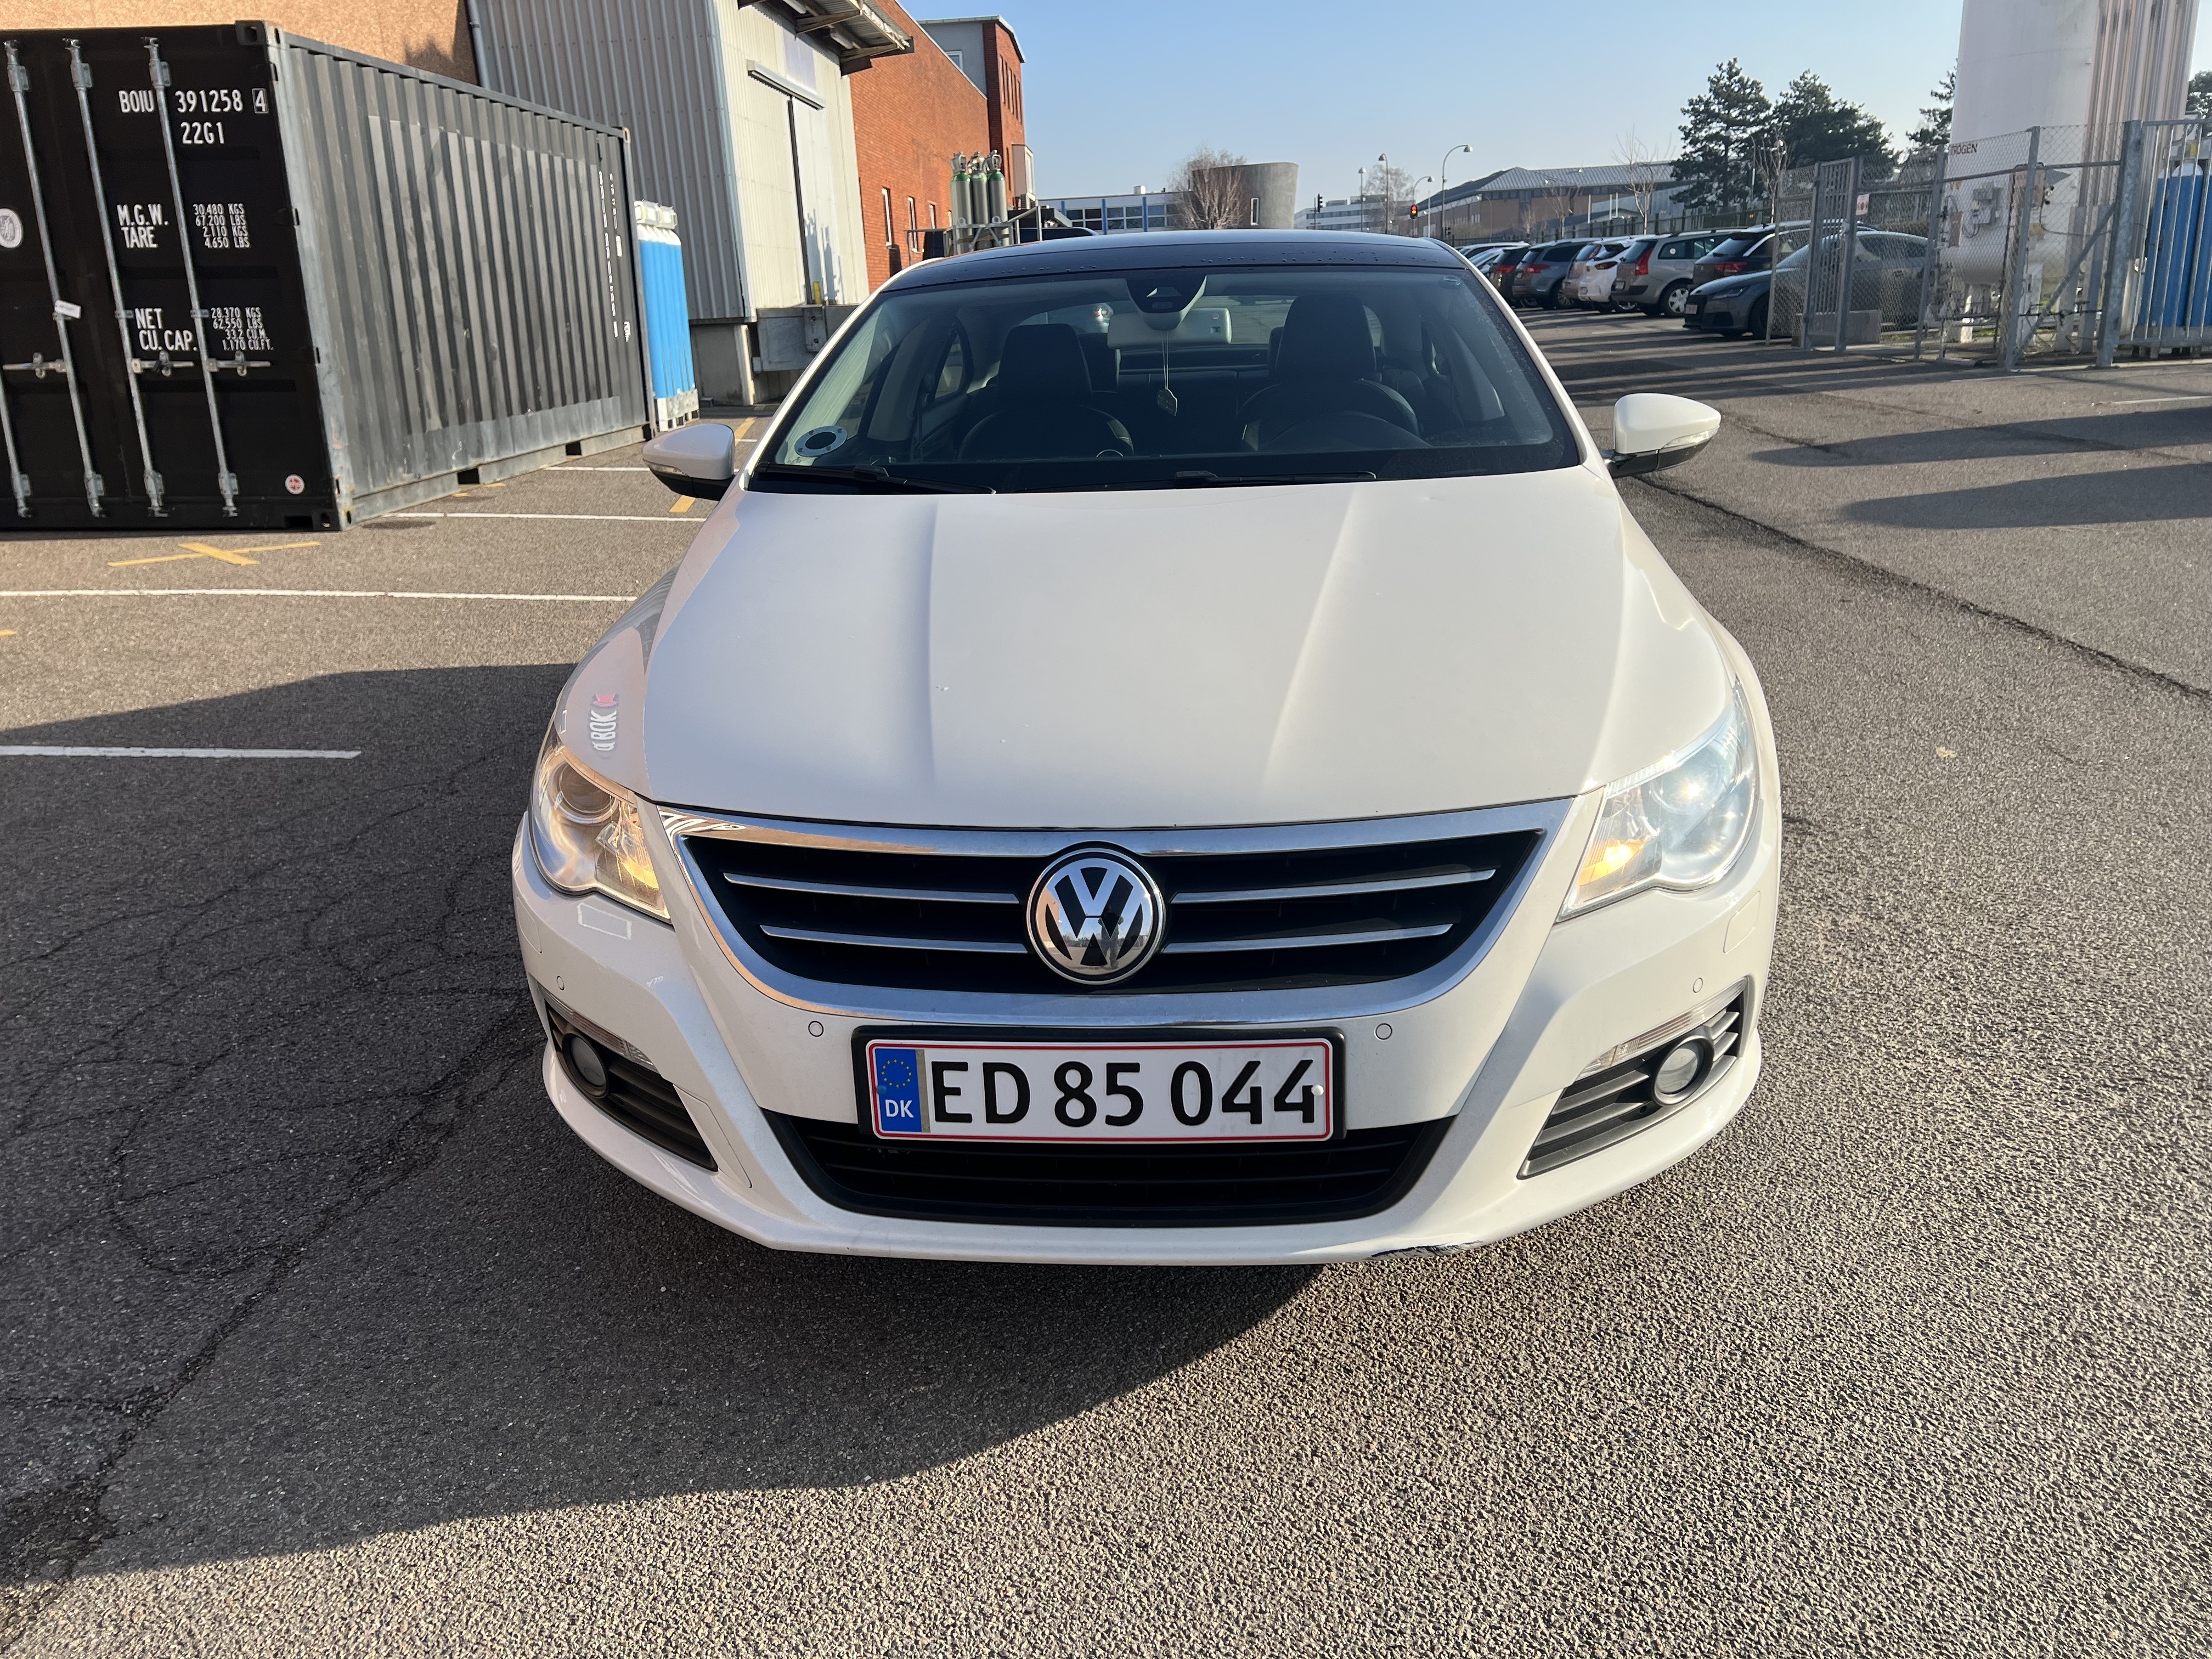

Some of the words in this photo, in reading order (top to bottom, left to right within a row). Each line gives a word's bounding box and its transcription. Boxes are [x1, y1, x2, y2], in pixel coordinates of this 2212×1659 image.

[119, 89, 155, 112] BOIU
[175, 89, 243, 112] 391258
[254, 89, 267, 113] 4
[180, 122, 224, 144] 22G1
[117, 204, 168, 225] M.G.W.
[228, 204, 245, 214] KGS
[195, 215, 225, 226] 67.200
[230, 215, 246, 225] LBS
[232, 226, 249, 236] KGS
[121, 226, 159, 248] TARE
[205, 237, 230, 249] 4.650
[234, 237, 251, 248] LBS
[134, 308, 163, 329] NET
[211, 307, 241, 318] 28.370
[245, 307, 262, 318] KGS
[247, 318, 263, 329] LBS
[139, 330, 162, 351] CU.
[164, 330, 198, 351] CAP.
[1035, 857, 1153, 975] VW
[930, 1060, 1031, 1124] ED
[1053, 1060, 1144, 1127] 85
[1170, 1059, 1316, 1126] 044
[885, 1099, 915, 1118] DK
